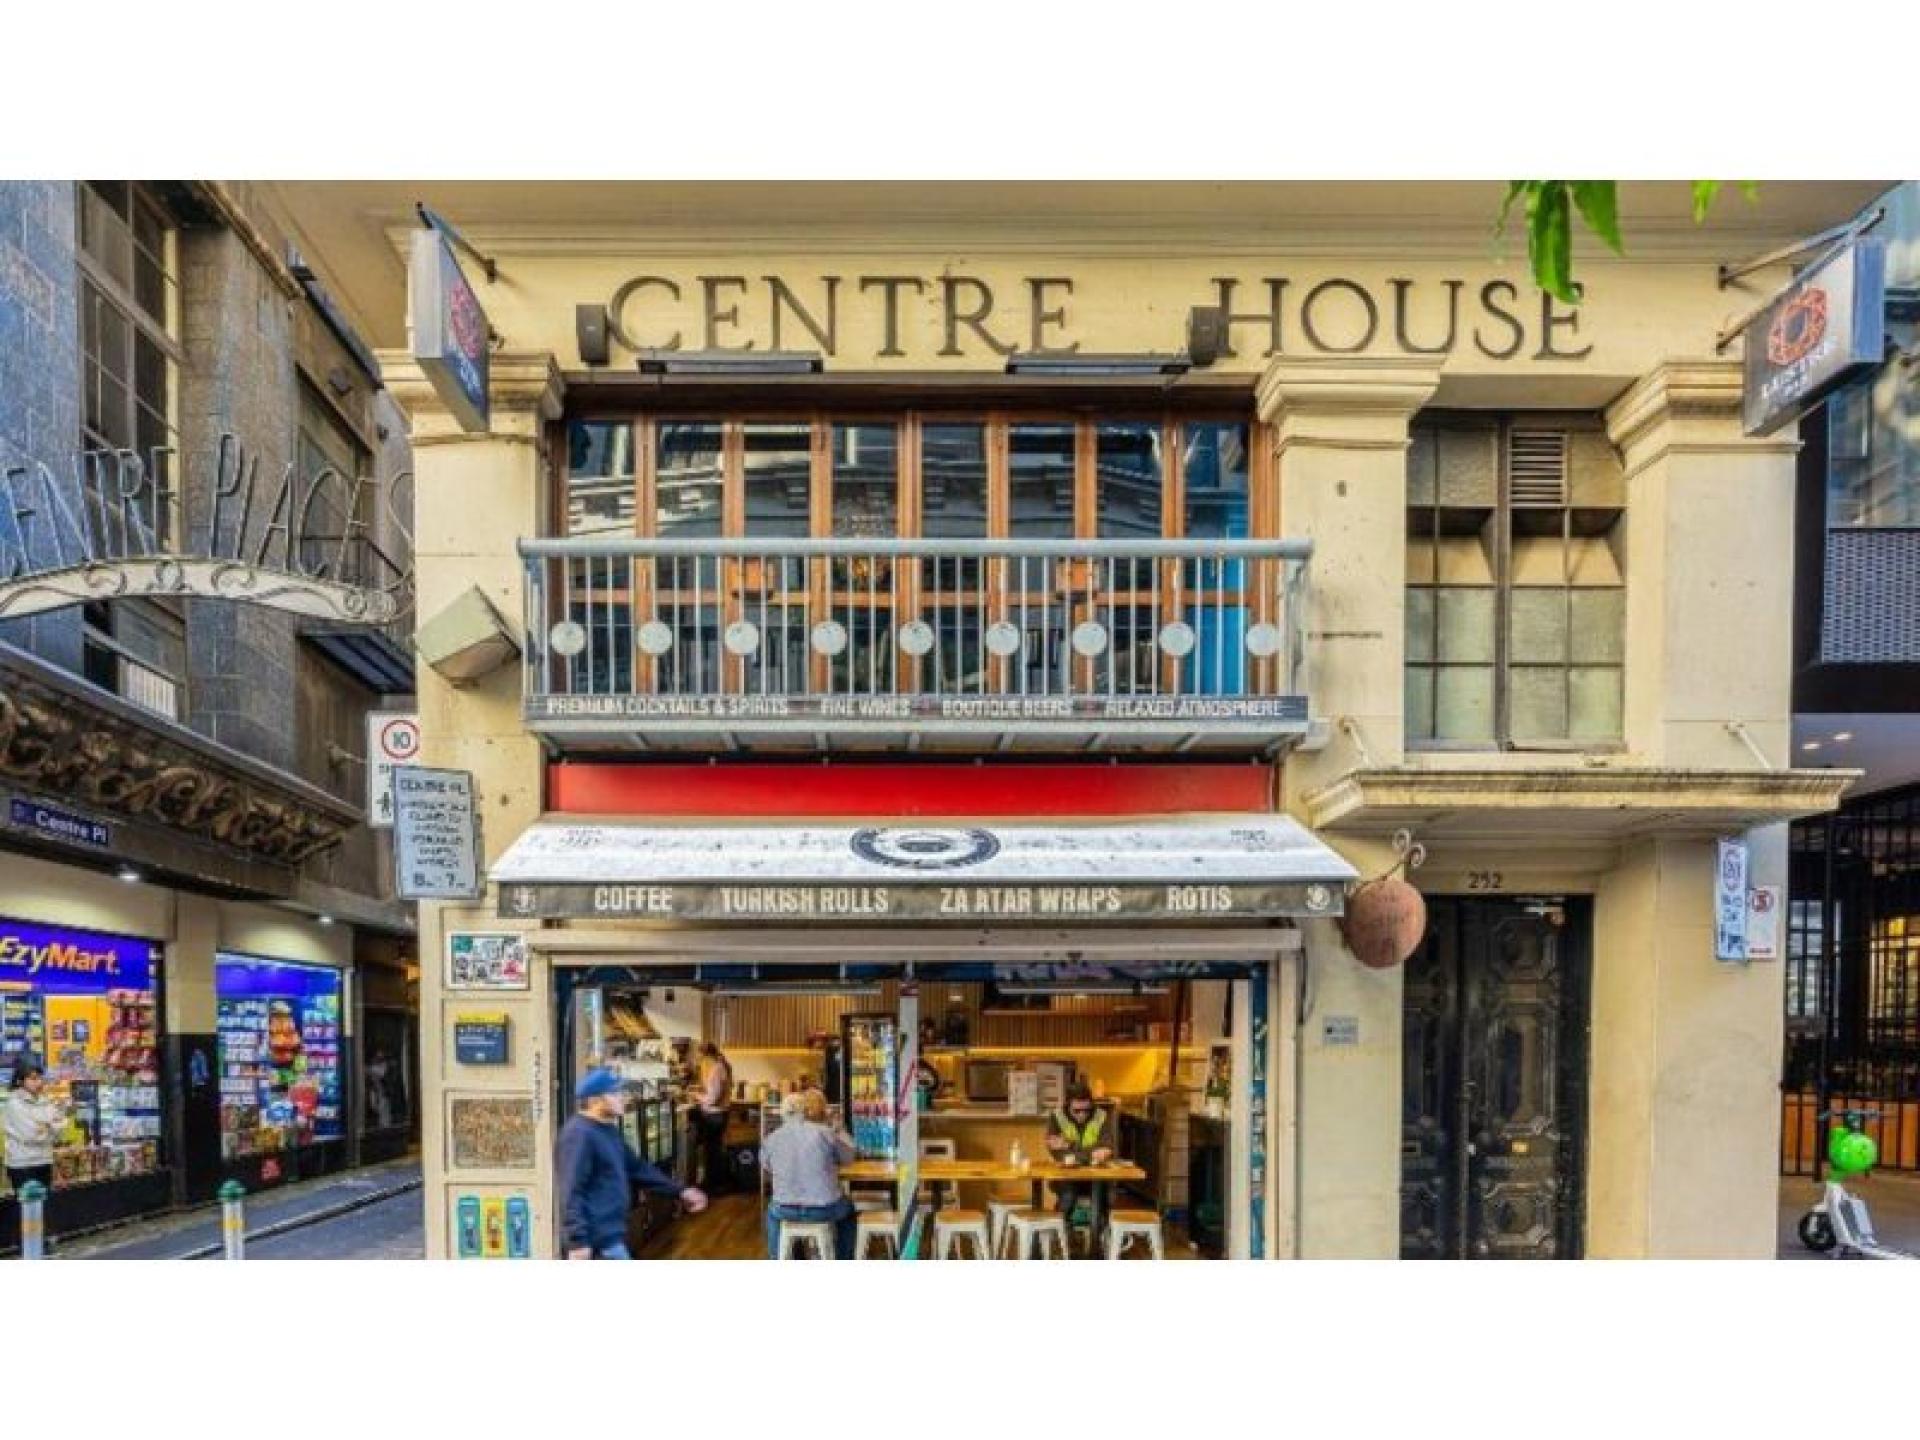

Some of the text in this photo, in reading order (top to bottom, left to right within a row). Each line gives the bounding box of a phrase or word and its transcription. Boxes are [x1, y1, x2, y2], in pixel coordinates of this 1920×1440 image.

[607, 274, 1595, 361] CENTRE HOUSE
[4, 446, 180, 578] ENTRE
[547, 697, 788, 714] PREMIUM COCKTAILS & SPIRITS
[820, 698, 911, 715] FINE WINES
[942, 698, 1074, 716] BOUTIQUE BEERS
[1104, 699, 1283, 717] RELAXED ATMOSPHERE
[35, 810, 89, 838] Centre
[594, 886, 673, 911] COFFEE
[719, 887, 889, 913] TURKISH ROLLS
[1038, 887, 1122, 913] WRAPS
[1167, 885, 1233, 911] ROTIS
